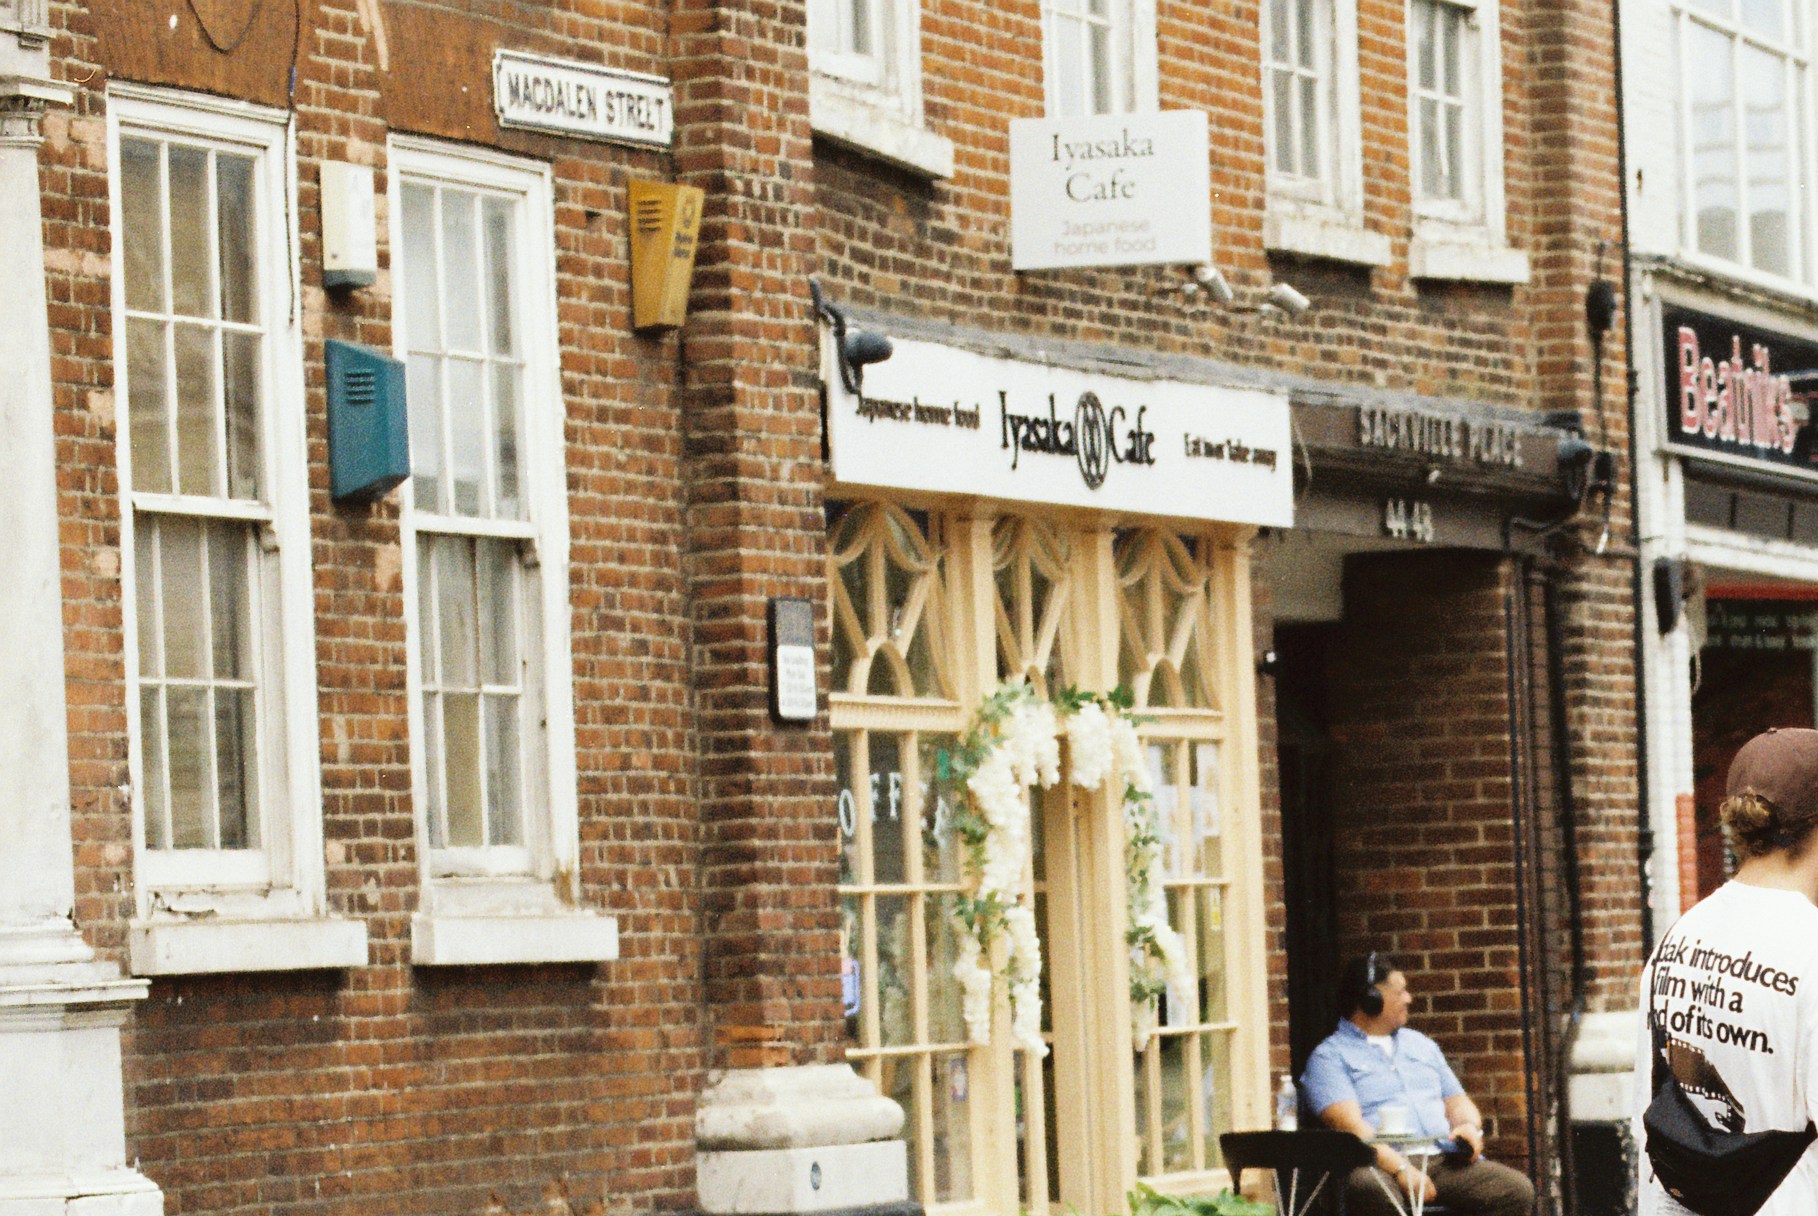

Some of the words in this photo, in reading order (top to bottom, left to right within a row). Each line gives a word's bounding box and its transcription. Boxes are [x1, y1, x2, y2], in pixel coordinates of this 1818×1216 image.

[605, 90, 664, 135] STREET
[1052, 128, 1155, 171] Iyasaka
[1065, 167, 1136, 203] Cafe
[1677, 325, 1796, 455] Beatniks
[998, 390, 1078, 472] Iyasaka
[1108, 404, 1156, 466] Cafe
[1690, 939, 1799, 996] introduces
[1691, 975, 1725, 1009] with
[1728, 991, 1744, 1013] a
[1670, 1004, 1696, 1034] of
[1696, 1006, 1713, 1039] its
[1716, 1022, 1774, 1054] own.
